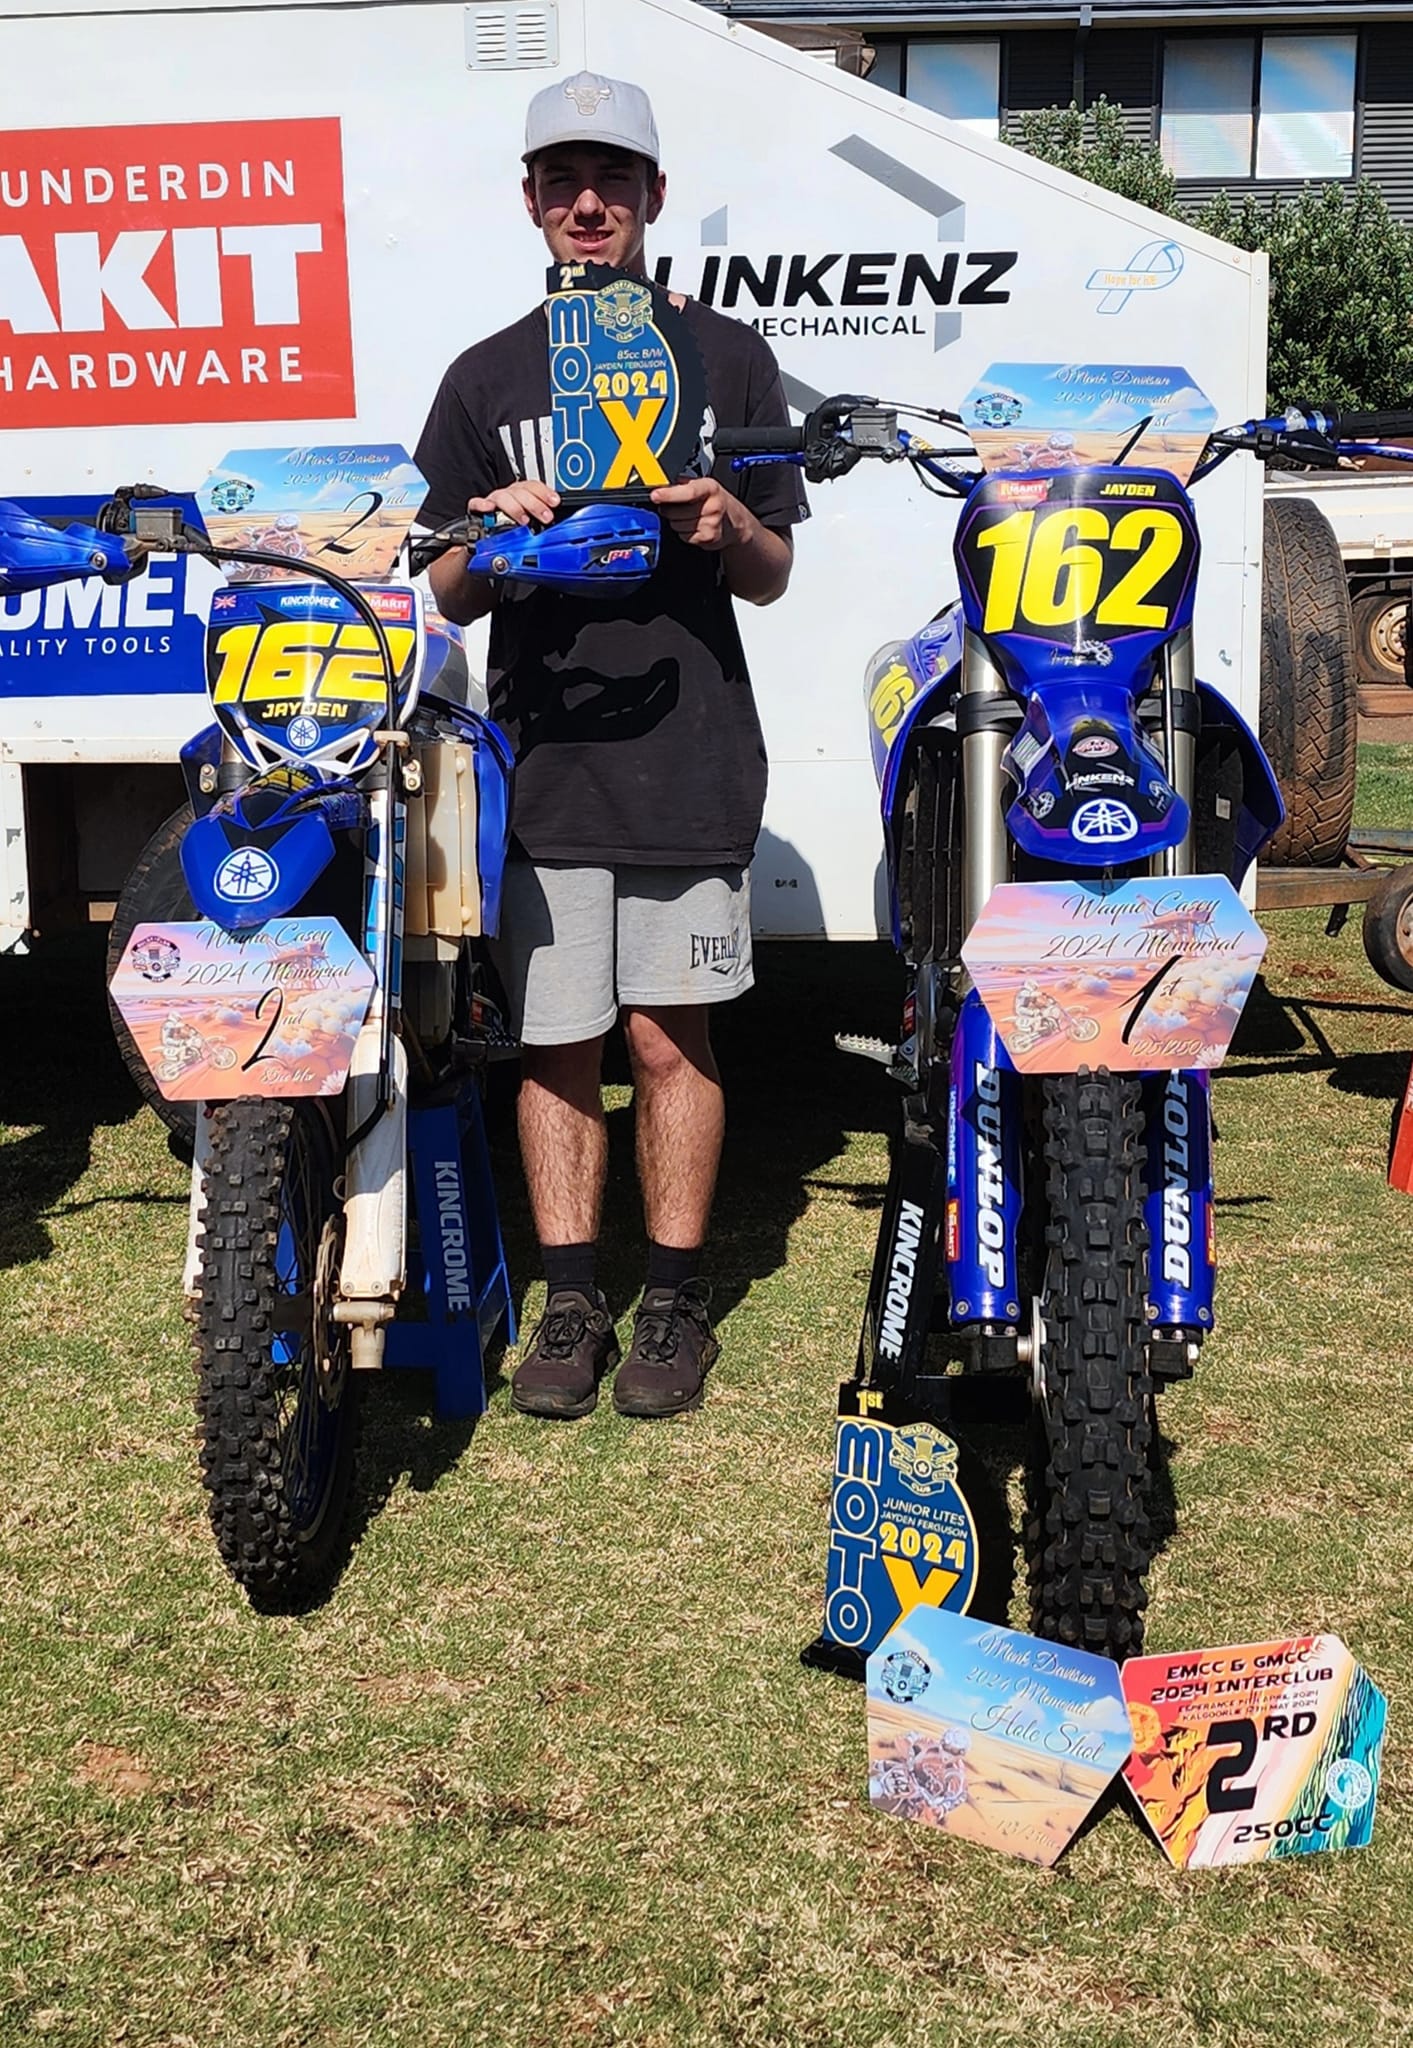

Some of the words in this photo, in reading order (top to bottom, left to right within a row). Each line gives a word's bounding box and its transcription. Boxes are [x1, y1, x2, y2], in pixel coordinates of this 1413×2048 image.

[560, 264, 586, 289] 2nd
[593, 370, 667, 399] 2024
[597, 397, 671, 490] X
[1100, 484, 1156, 496] JAYDEN
[977, 507, 1183, 634] 162
[280, 595, 330, 609] KINCROME
[0, 638, 68, 657] LITY
[85, 636, 171, 655] TOOLS
[213, 620, 416, 705] 162
[262, 702, 348, 718] JAYDEN
[1152, 891, 1220, 921] Casey
[275, 921, 332, 951] Casey
[1040, 933, 1119, 959] 2024
[1124, 931, 1244, 958] Memorial
[181, 961, 249, 986] 2024
[251, 959, 354, 985] Memorial
[976, 1061, 1004, 1288] DUNLOP
[434, 1161, 472, 1312] KINCROME
[880, 1200, 925, 1361] KINCROME
[880, 1511, 916, 1527] JAYDEN
[917, 1518, 968, 1539] FERGUSON
[883, 1497, 931, 1518] JUNIOR
[933, 1509, 965, 1527] LITES
[879, 1521, 966, 1570] 2024
[1167, 1659, 1225, 1682] EMCC
[1253, 1649, 1312, 1669] GMCC
[1151, 1682, 1209, 1703] 2024
[1214, 1667, 1334, 1694] INTERCLUB
[1269, 1701, 1290, 1711] MAY
[970, 1704, 1041, 1743] Hole
[1044, 1723, 1106, 1763] Shot
